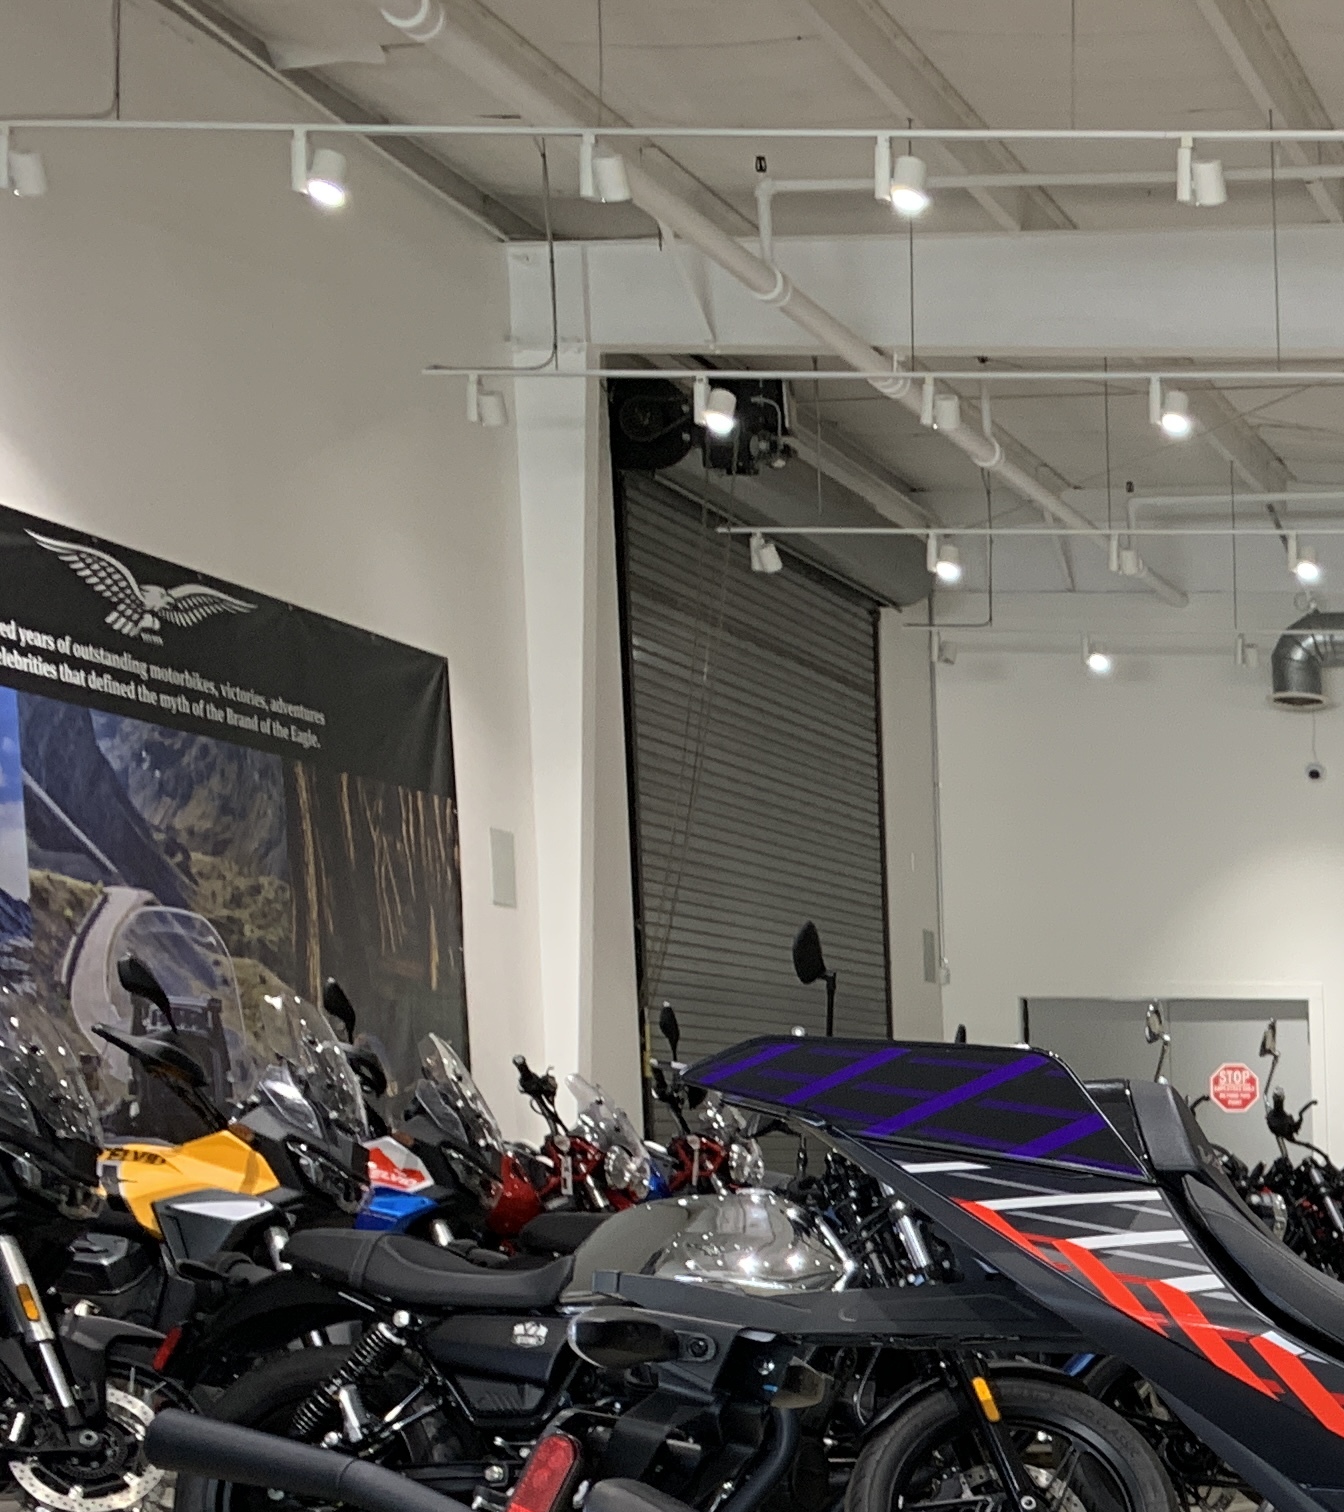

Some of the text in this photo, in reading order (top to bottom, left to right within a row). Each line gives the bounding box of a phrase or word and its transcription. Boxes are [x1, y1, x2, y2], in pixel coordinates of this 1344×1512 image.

[18, 626, 56, 651] years
[56, 635, 73, 656] of
[72, 644, 149, 681] outstanding
[149, 664, 219, 698] motorbikes,
[220, 681, 269, 712] victories,
[269, 696, 326, 726] adventures
[58, 662, 87, 687] that
[87, 669, 136, 700] defined
[137, 684, 158, 706] the
[158, 693, 191, 715] myth
[191, 699, 205, 719] of
[206, 701, 226, 723] the
[226, 706, 259, 732] Brand
[259, 717, 272, 735] of
[272, 720, 290, 741] the
[290, 724, 321, 749] Eagle.
[1219, 1069, 1250, 1085] STOP
